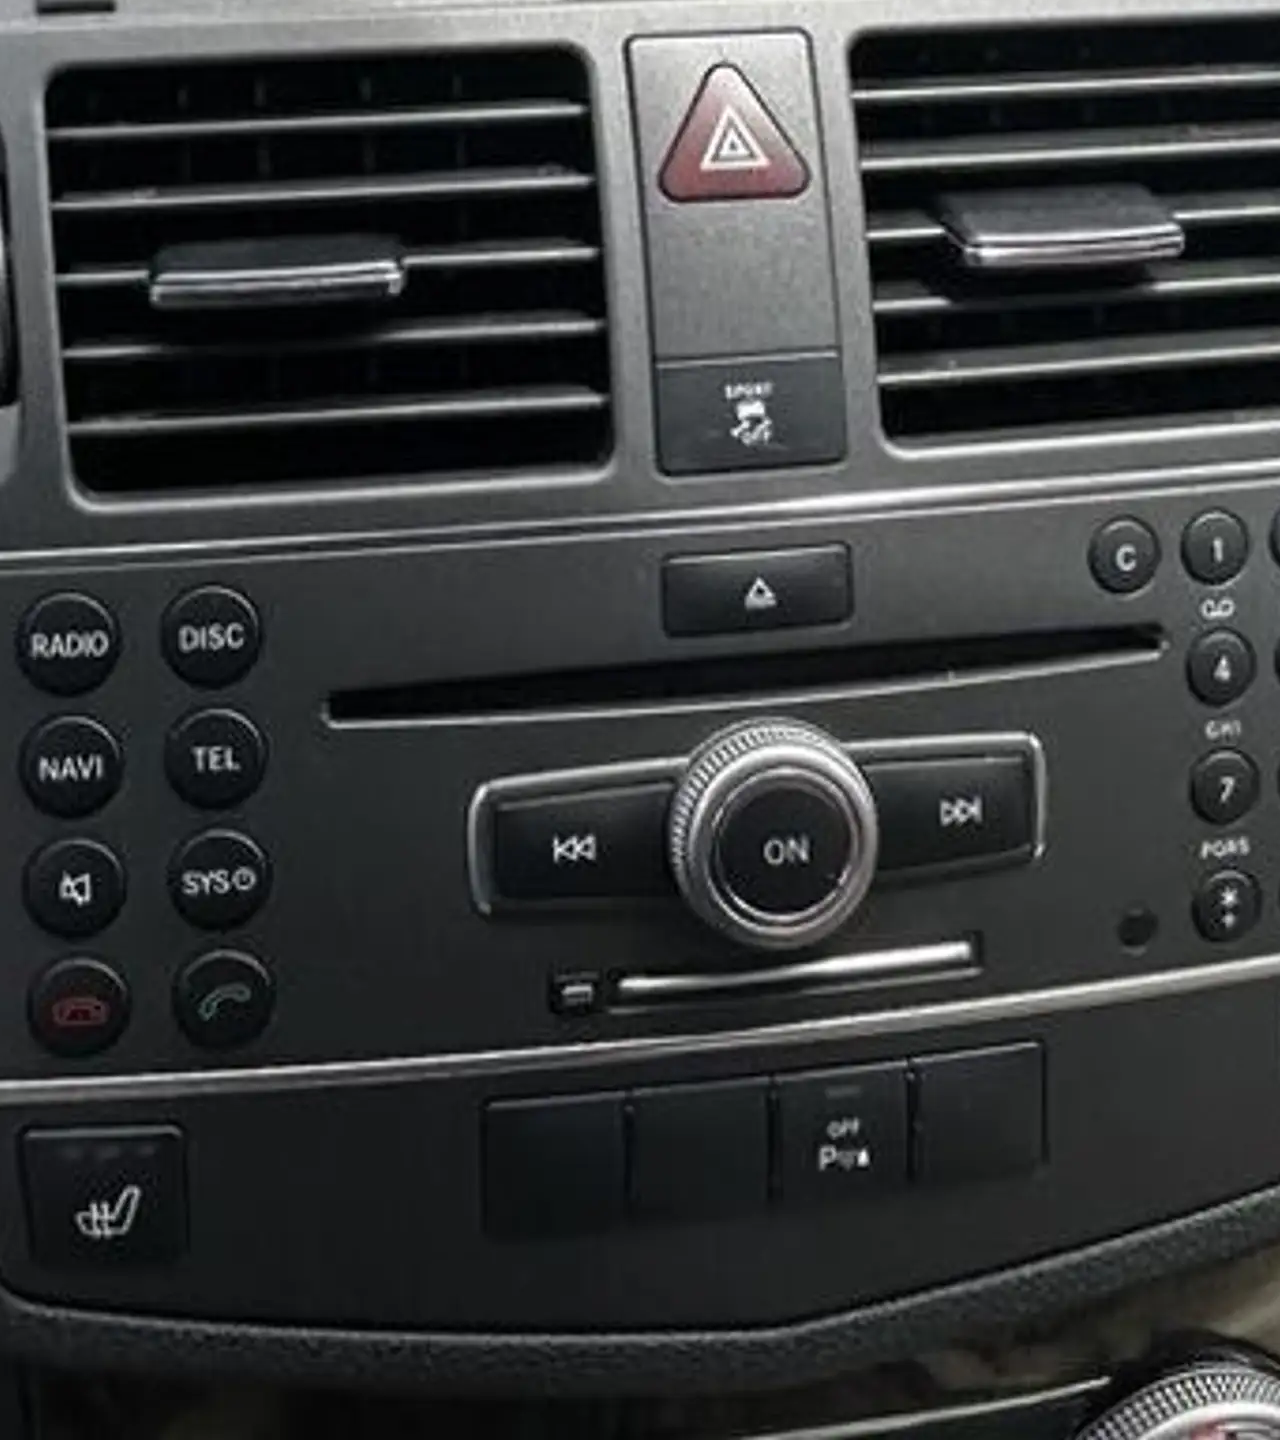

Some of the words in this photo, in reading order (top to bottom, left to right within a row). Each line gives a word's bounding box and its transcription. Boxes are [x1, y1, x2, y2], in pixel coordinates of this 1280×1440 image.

[1116, 546, 1138, 572] C
[1212, 540, 1225, 564] 1
[31, 630, 110, 659] RADIO
[177, 622, 246, 654] DISC
[1213, 654, 1232, 682] 4
[37, 755, 104, 783] NAVI
[190, 745, 242, 773] TEL
[1218, 776, 1236, 804] 7
[762, 838, 810, 866] ON
[181, 868, 231, 898] SYS
